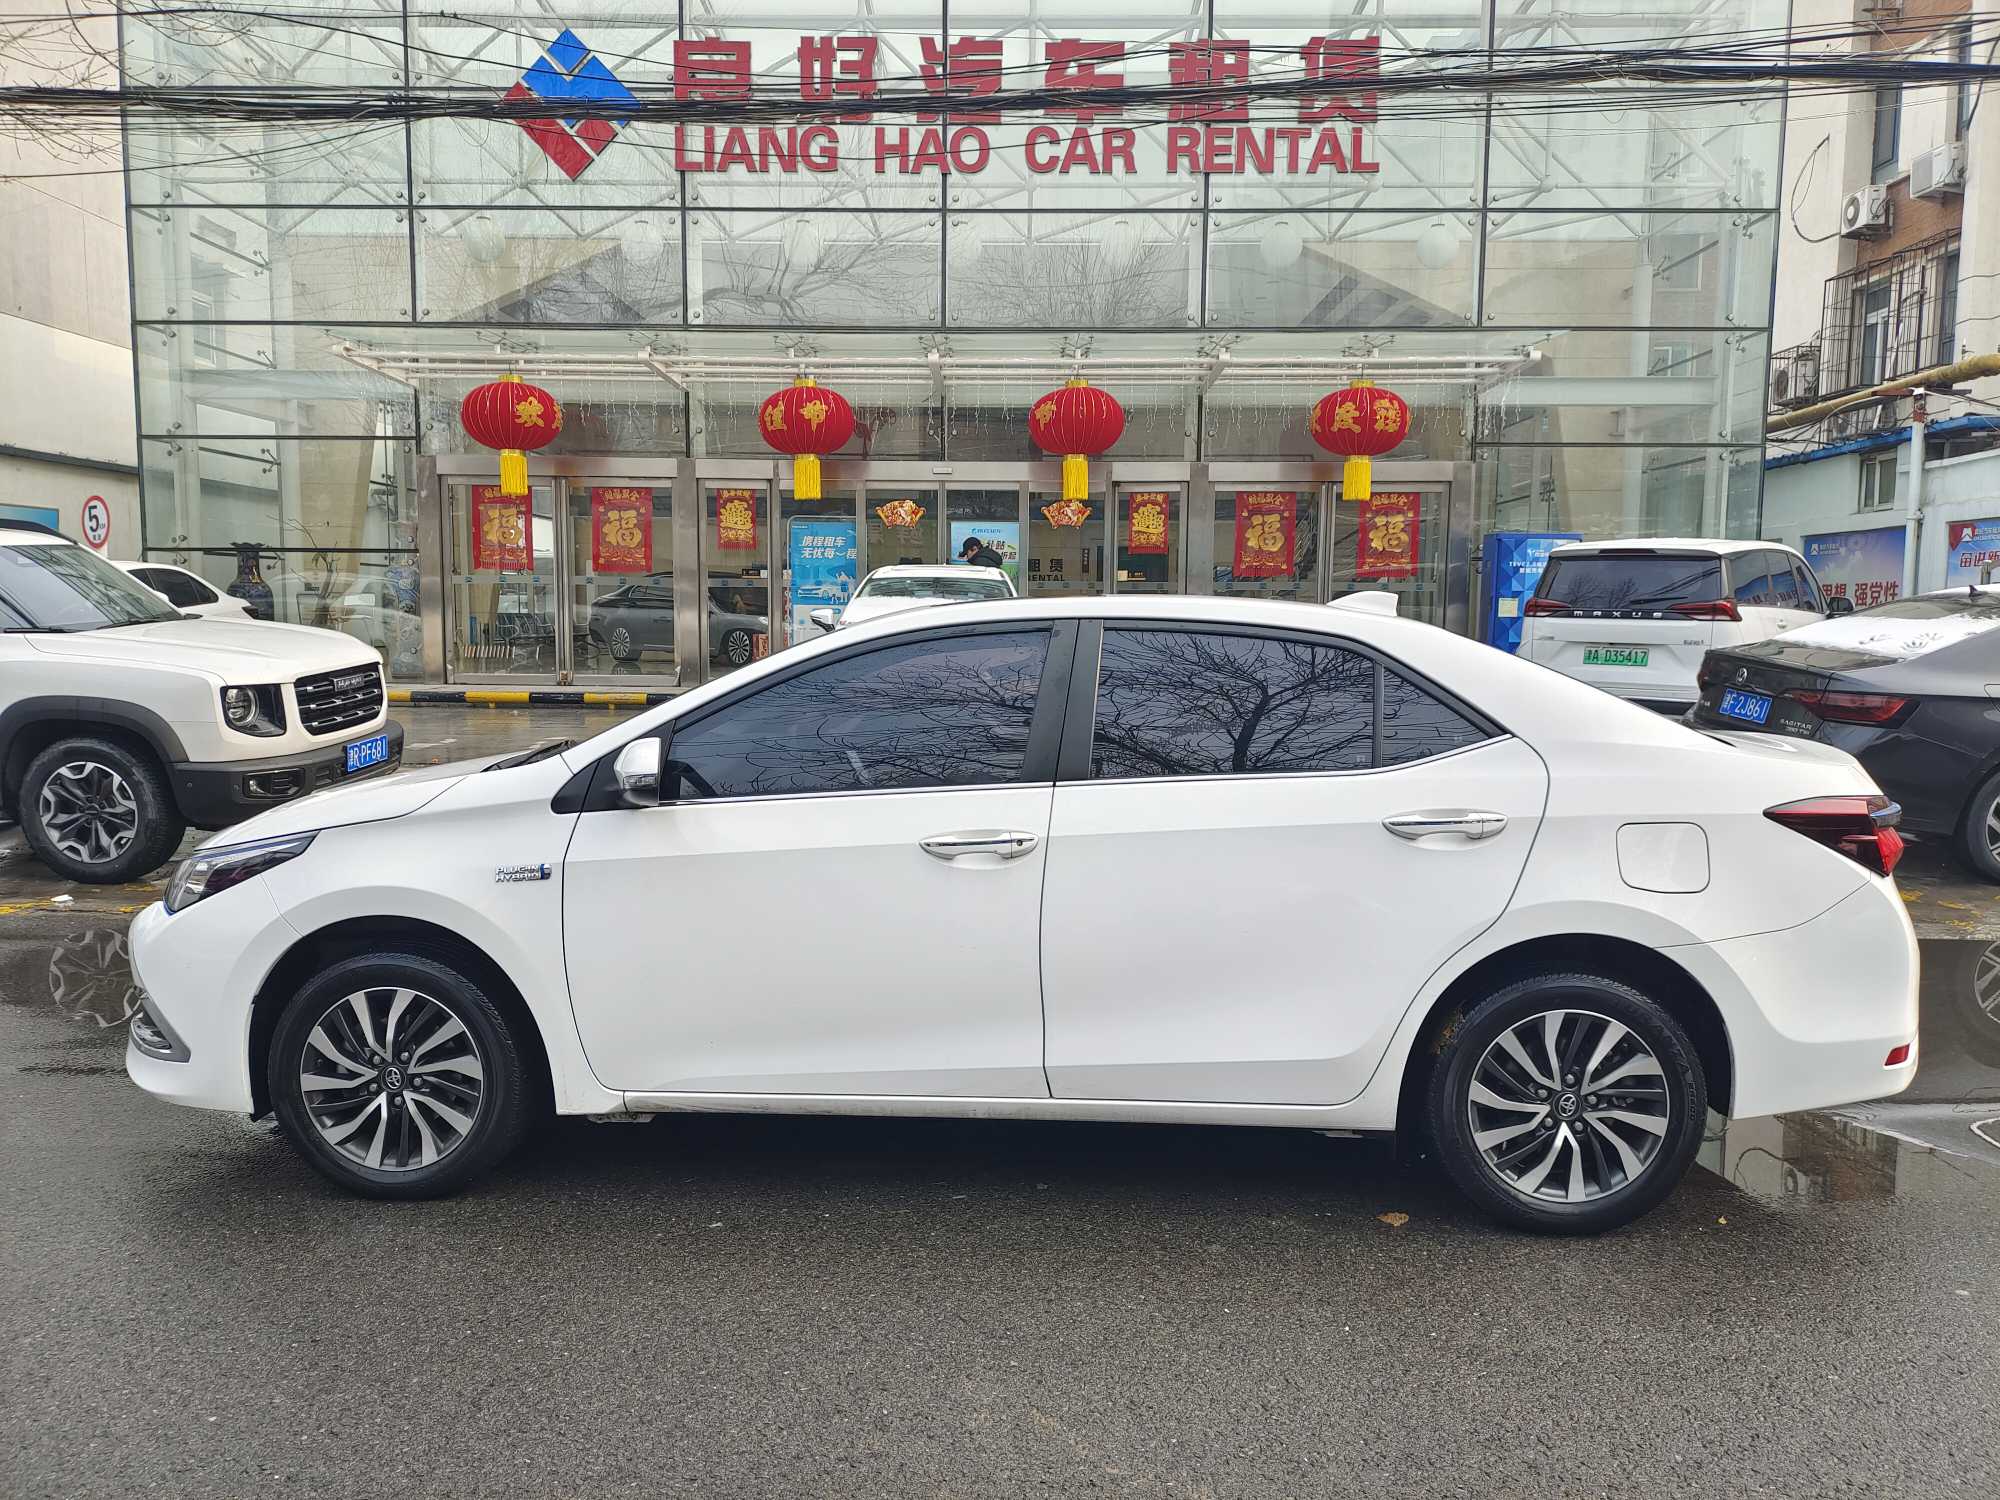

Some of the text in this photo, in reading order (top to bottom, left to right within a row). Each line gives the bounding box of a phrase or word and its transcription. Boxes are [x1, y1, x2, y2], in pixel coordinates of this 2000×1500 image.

[674, 126, 1380, 174] LIANG HAO CAR RENTAL
[88, 505, 99, 532] 5
[602, 510, 642, 548] 福
[1245, 513, 1285, 552] 福
[1368, 514, 1410, 553] 福
[1573, 610, 1663, 619] MAXUS
